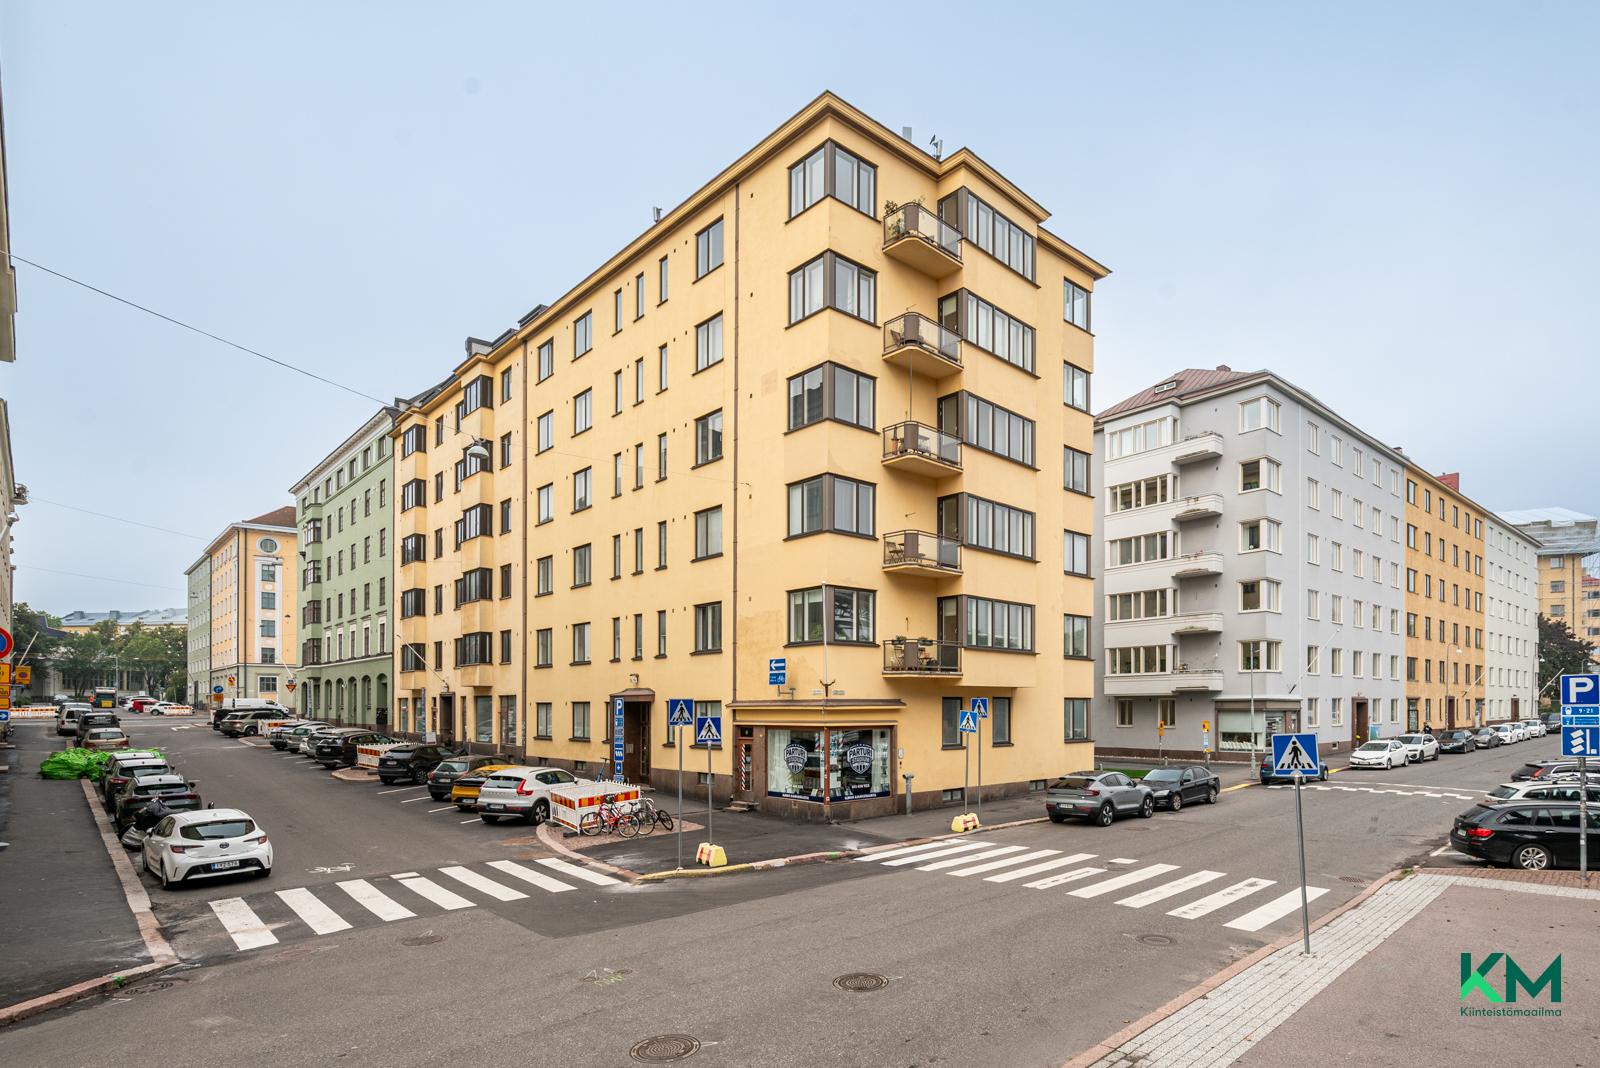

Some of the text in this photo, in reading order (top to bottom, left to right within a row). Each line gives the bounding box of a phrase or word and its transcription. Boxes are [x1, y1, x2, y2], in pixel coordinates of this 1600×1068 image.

[1569, 677, 1594, 703] P
[616, 699, 623, 715] P
[786, 748, 806, 758] PARTURI
[849, 748, 873, 758] PARTURI
